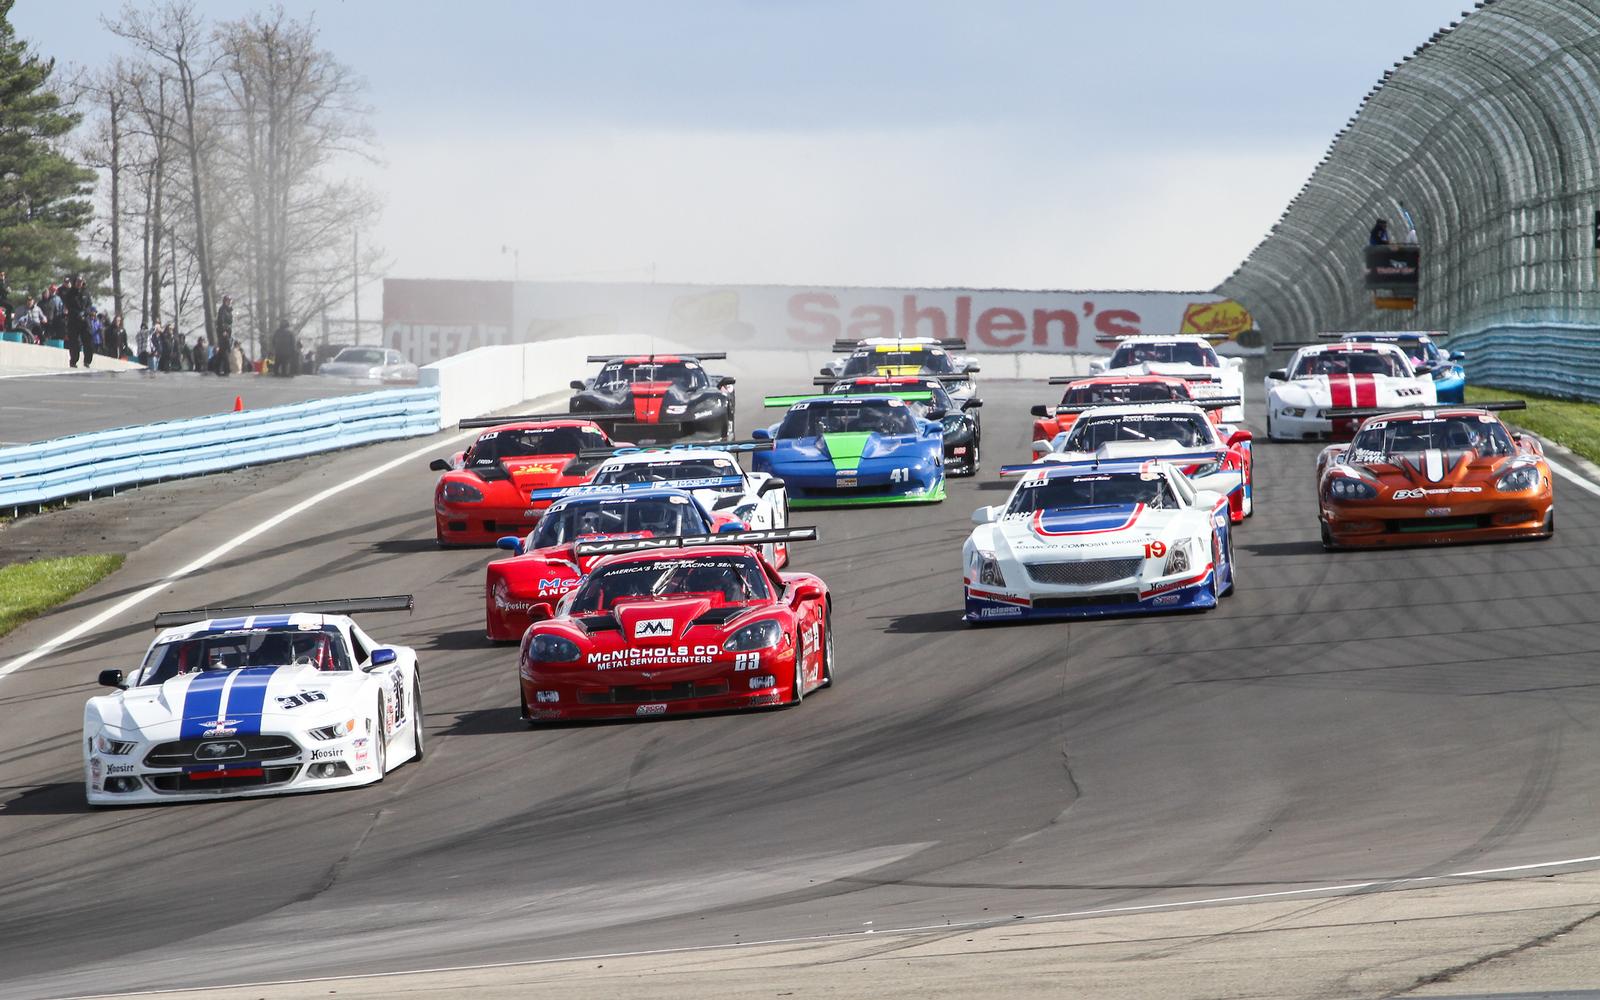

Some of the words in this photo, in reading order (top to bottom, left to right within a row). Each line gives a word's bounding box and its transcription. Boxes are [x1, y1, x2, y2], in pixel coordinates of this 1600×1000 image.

[786, 292, 1142, 349] Sahlen's
[890, 467, 909, 483] 41
[1144, 541, 1166, 559] 19
[604, 566, 651, 577] AMERICA'S
[680, 561, 714, 569] RACING
[538, 587, 569, 597] AND
[588, 646, 688, 664] McNICHOLS
[694, 645, 723, 655] CO.
[735, 651, 759, 671] 23
[597, 661, 628, 671] METAL
[630, 656, 668, 667] SERVICE
[670, 655, 713, 664] CENTERS
[275, 690, 328, 710] 36
[311, 748, 344, 761] Hoosier
[106, 763, 135, 775] Hoosier
